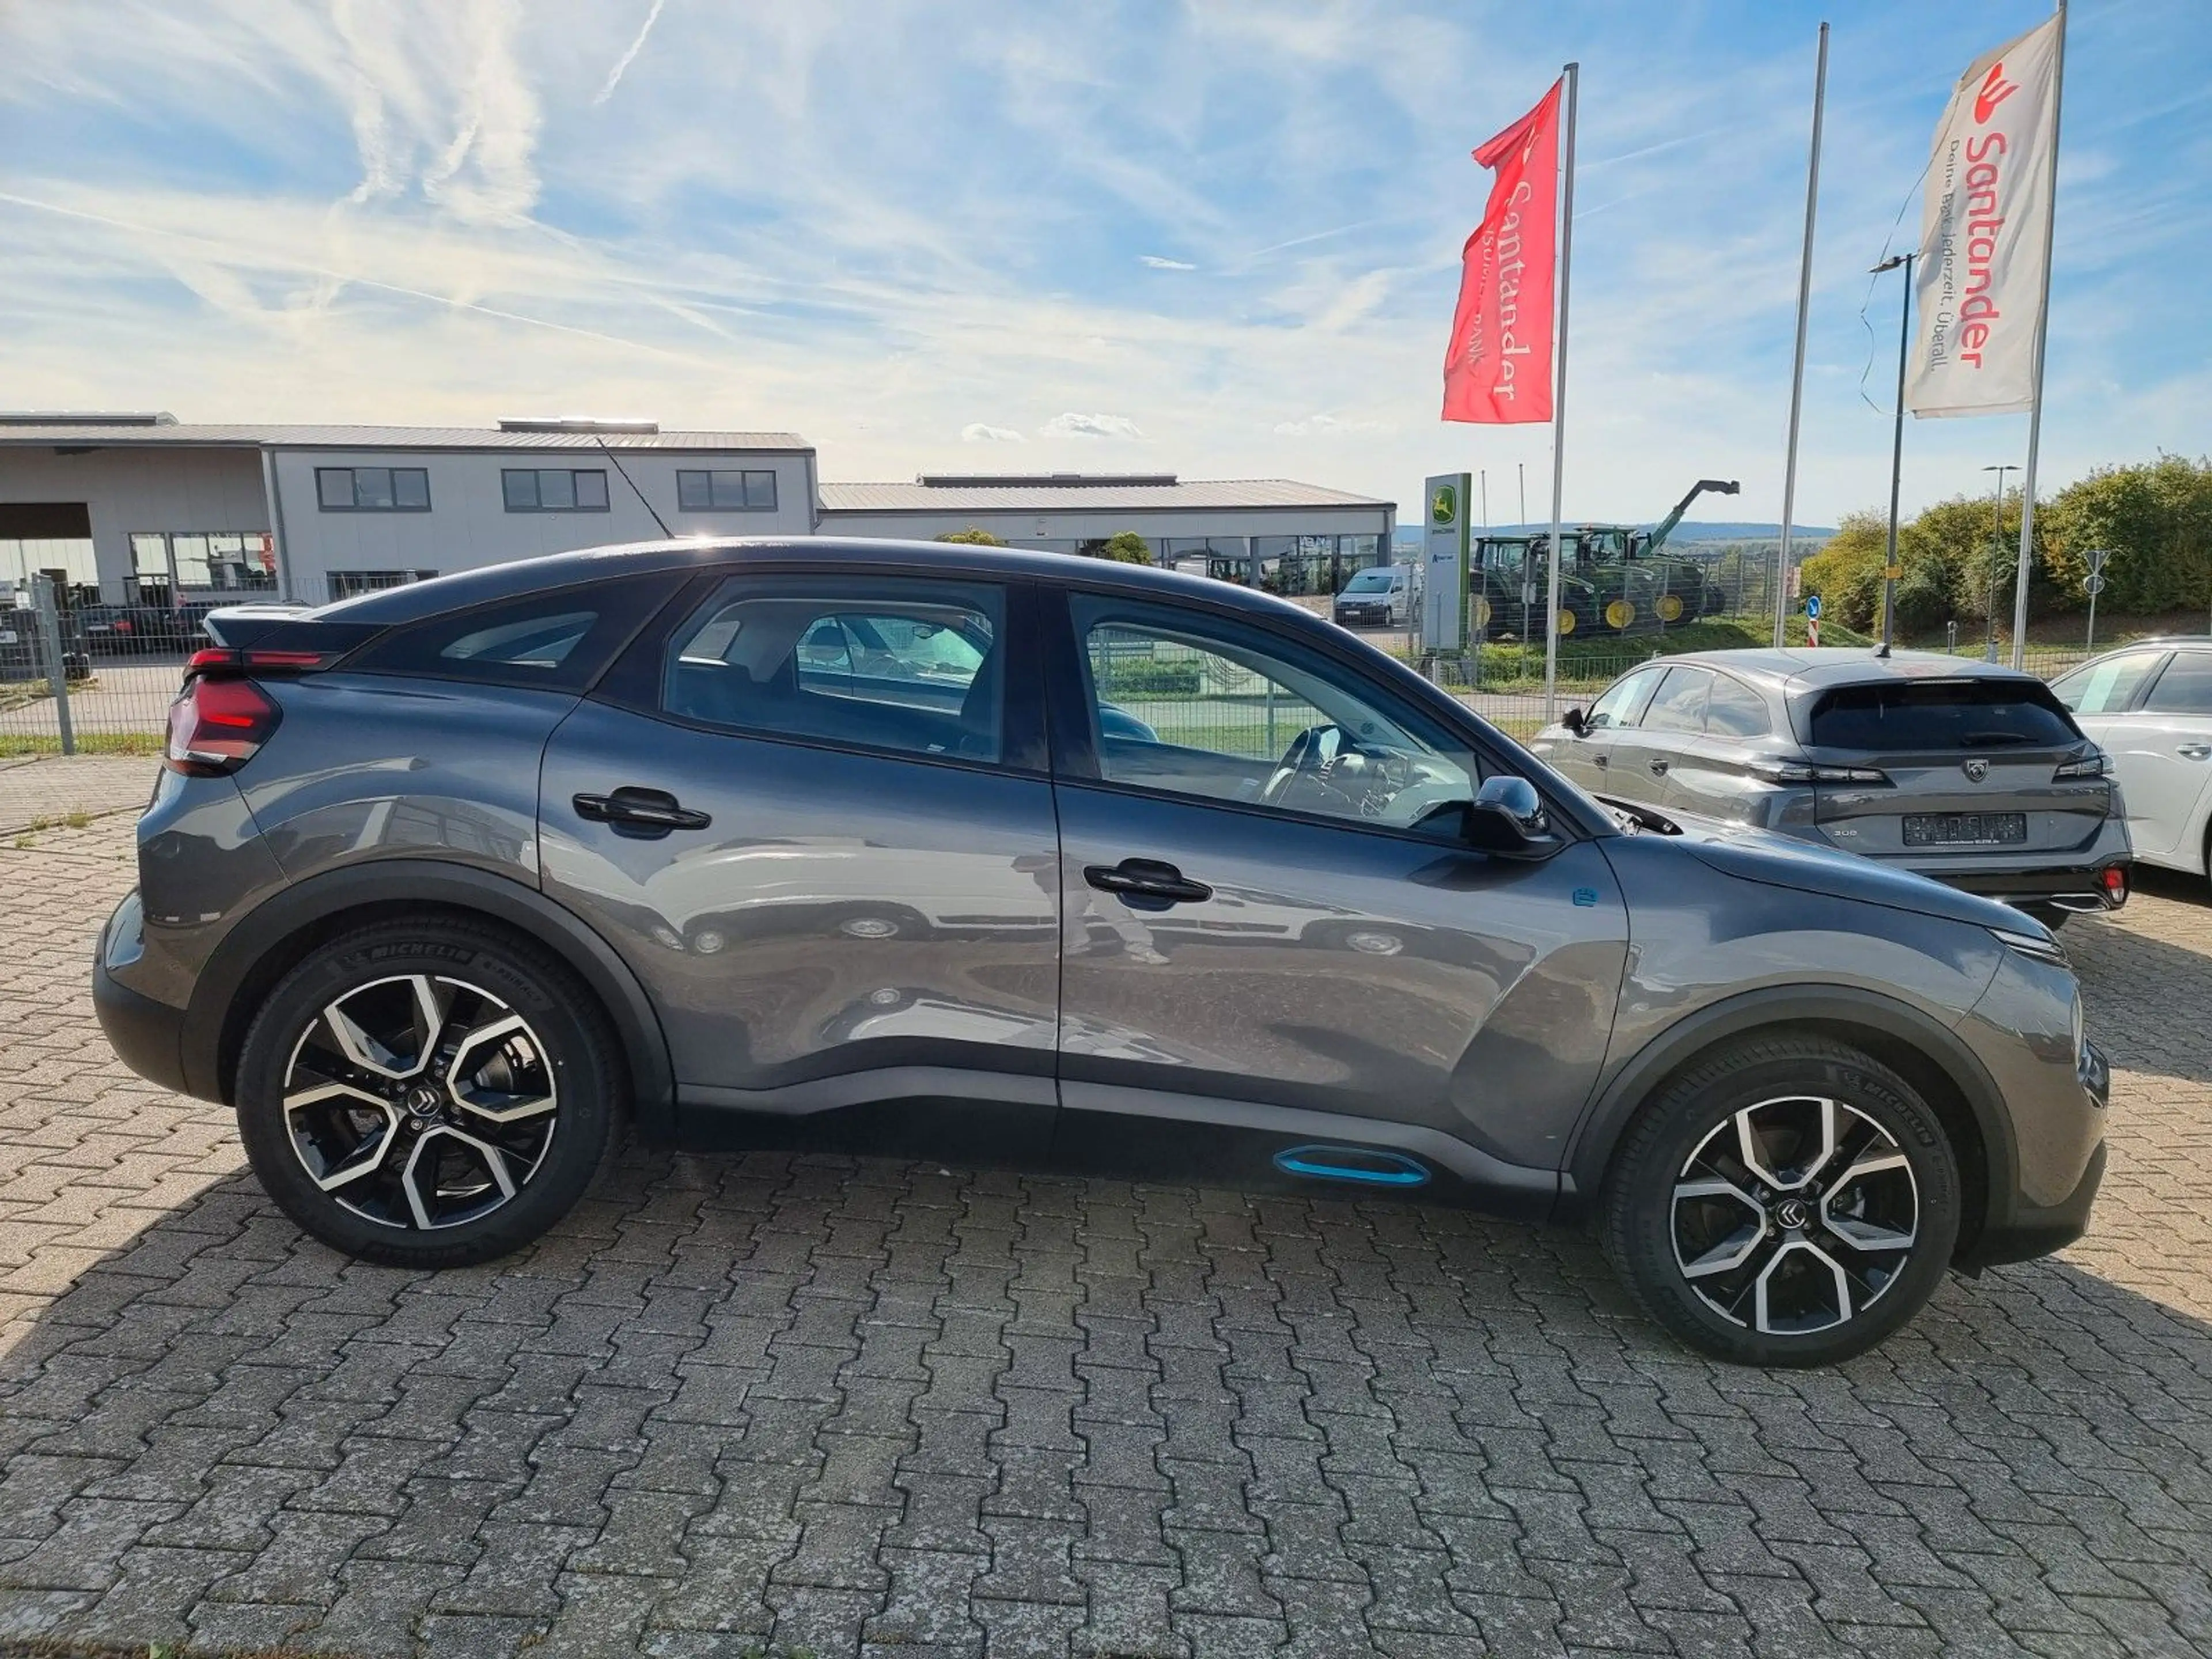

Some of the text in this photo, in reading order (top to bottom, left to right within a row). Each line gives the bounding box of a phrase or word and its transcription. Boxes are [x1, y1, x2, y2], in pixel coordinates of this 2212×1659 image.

[1940, 233, 1957, 306] Jederzeit.
[1959, 132, 2006, 370] Santander
[1493, 180, 1531, 402] Santander
[1930, 311, 1955, 373] Überall.
[371, 944, 472, 963] MICHELIN
[1864, 1082, 1934, 1145] MICHELIN
